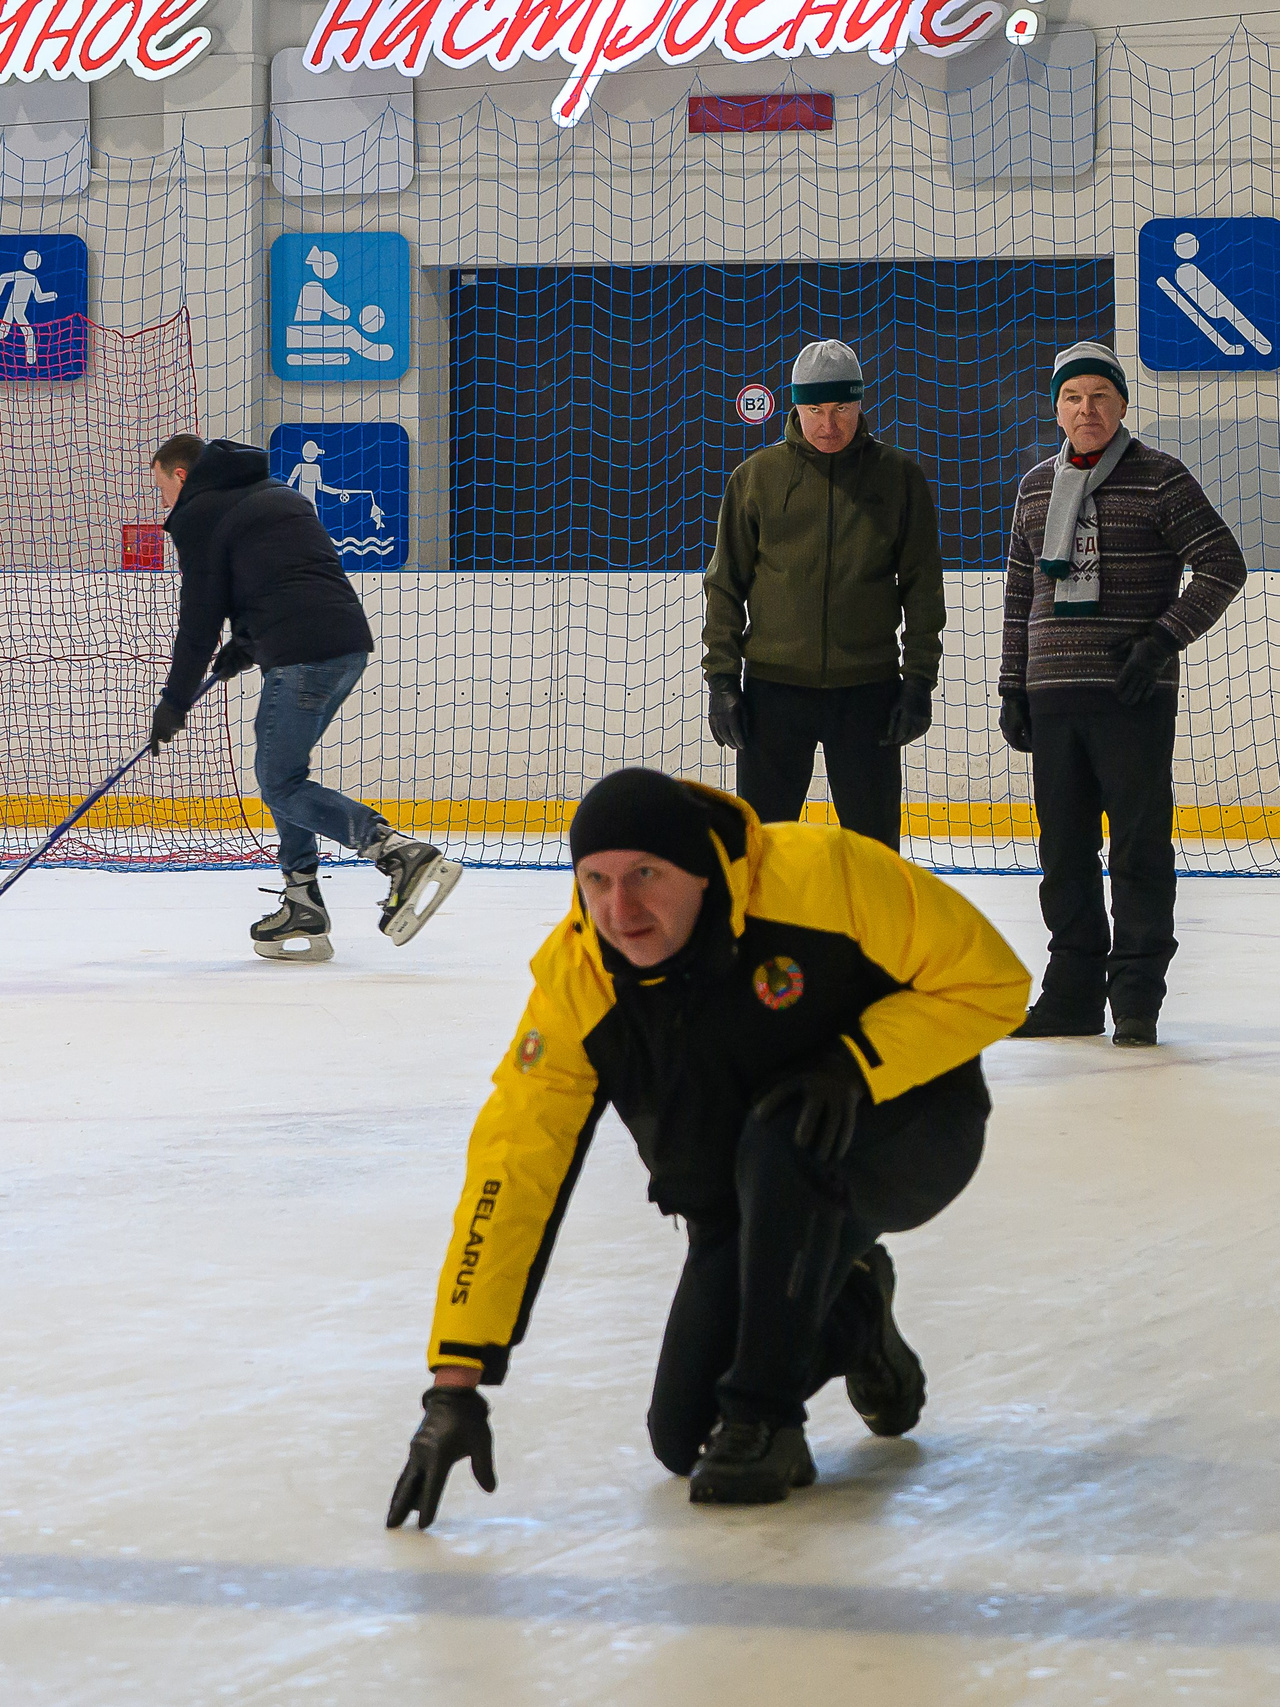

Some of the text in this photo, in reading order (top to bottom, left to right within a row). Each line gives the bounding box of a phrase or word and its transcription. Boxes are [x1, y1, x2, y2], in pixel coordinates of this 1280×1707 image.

[310, 0, 1030, 120] настроение
[1075, 536, 1097, 556] ЕД
[451, 1179, 502, 1306] BELARUS
